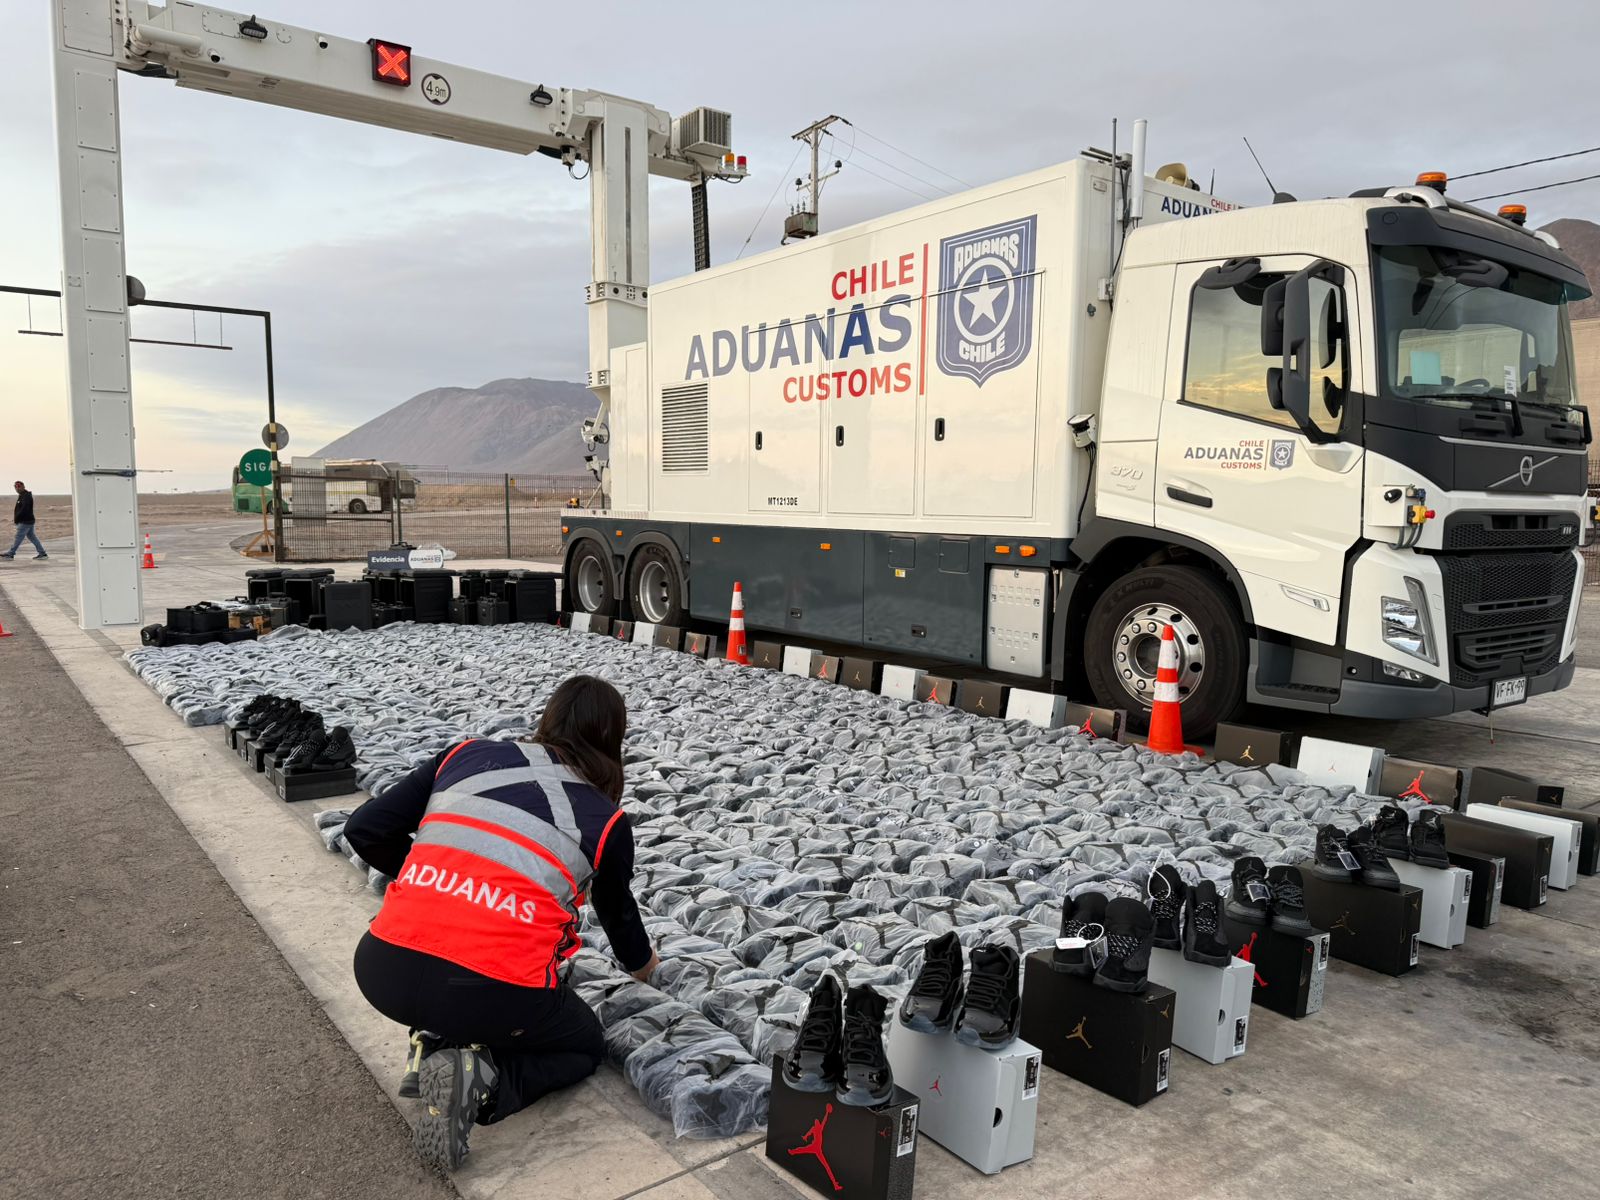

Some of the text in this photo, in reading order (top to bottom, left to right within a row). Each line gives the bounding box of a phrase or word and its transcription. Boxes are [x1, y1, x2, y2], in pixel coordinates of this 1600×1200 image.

[831, 252, 915, 300] CHILE
[953, 233, 1020, 284] ADUANAS
[684, 294, 912, 381] ADUANAS
[958, 331, 1006, 363] CHILE
[783, 362, 912, 403] CUSTOMS
[1184, 447, 1264, 460] ADUANAS
[1220, 461, 1262, 470] CUSTOMS
[400, 863, 537, 923] ADUANAS
